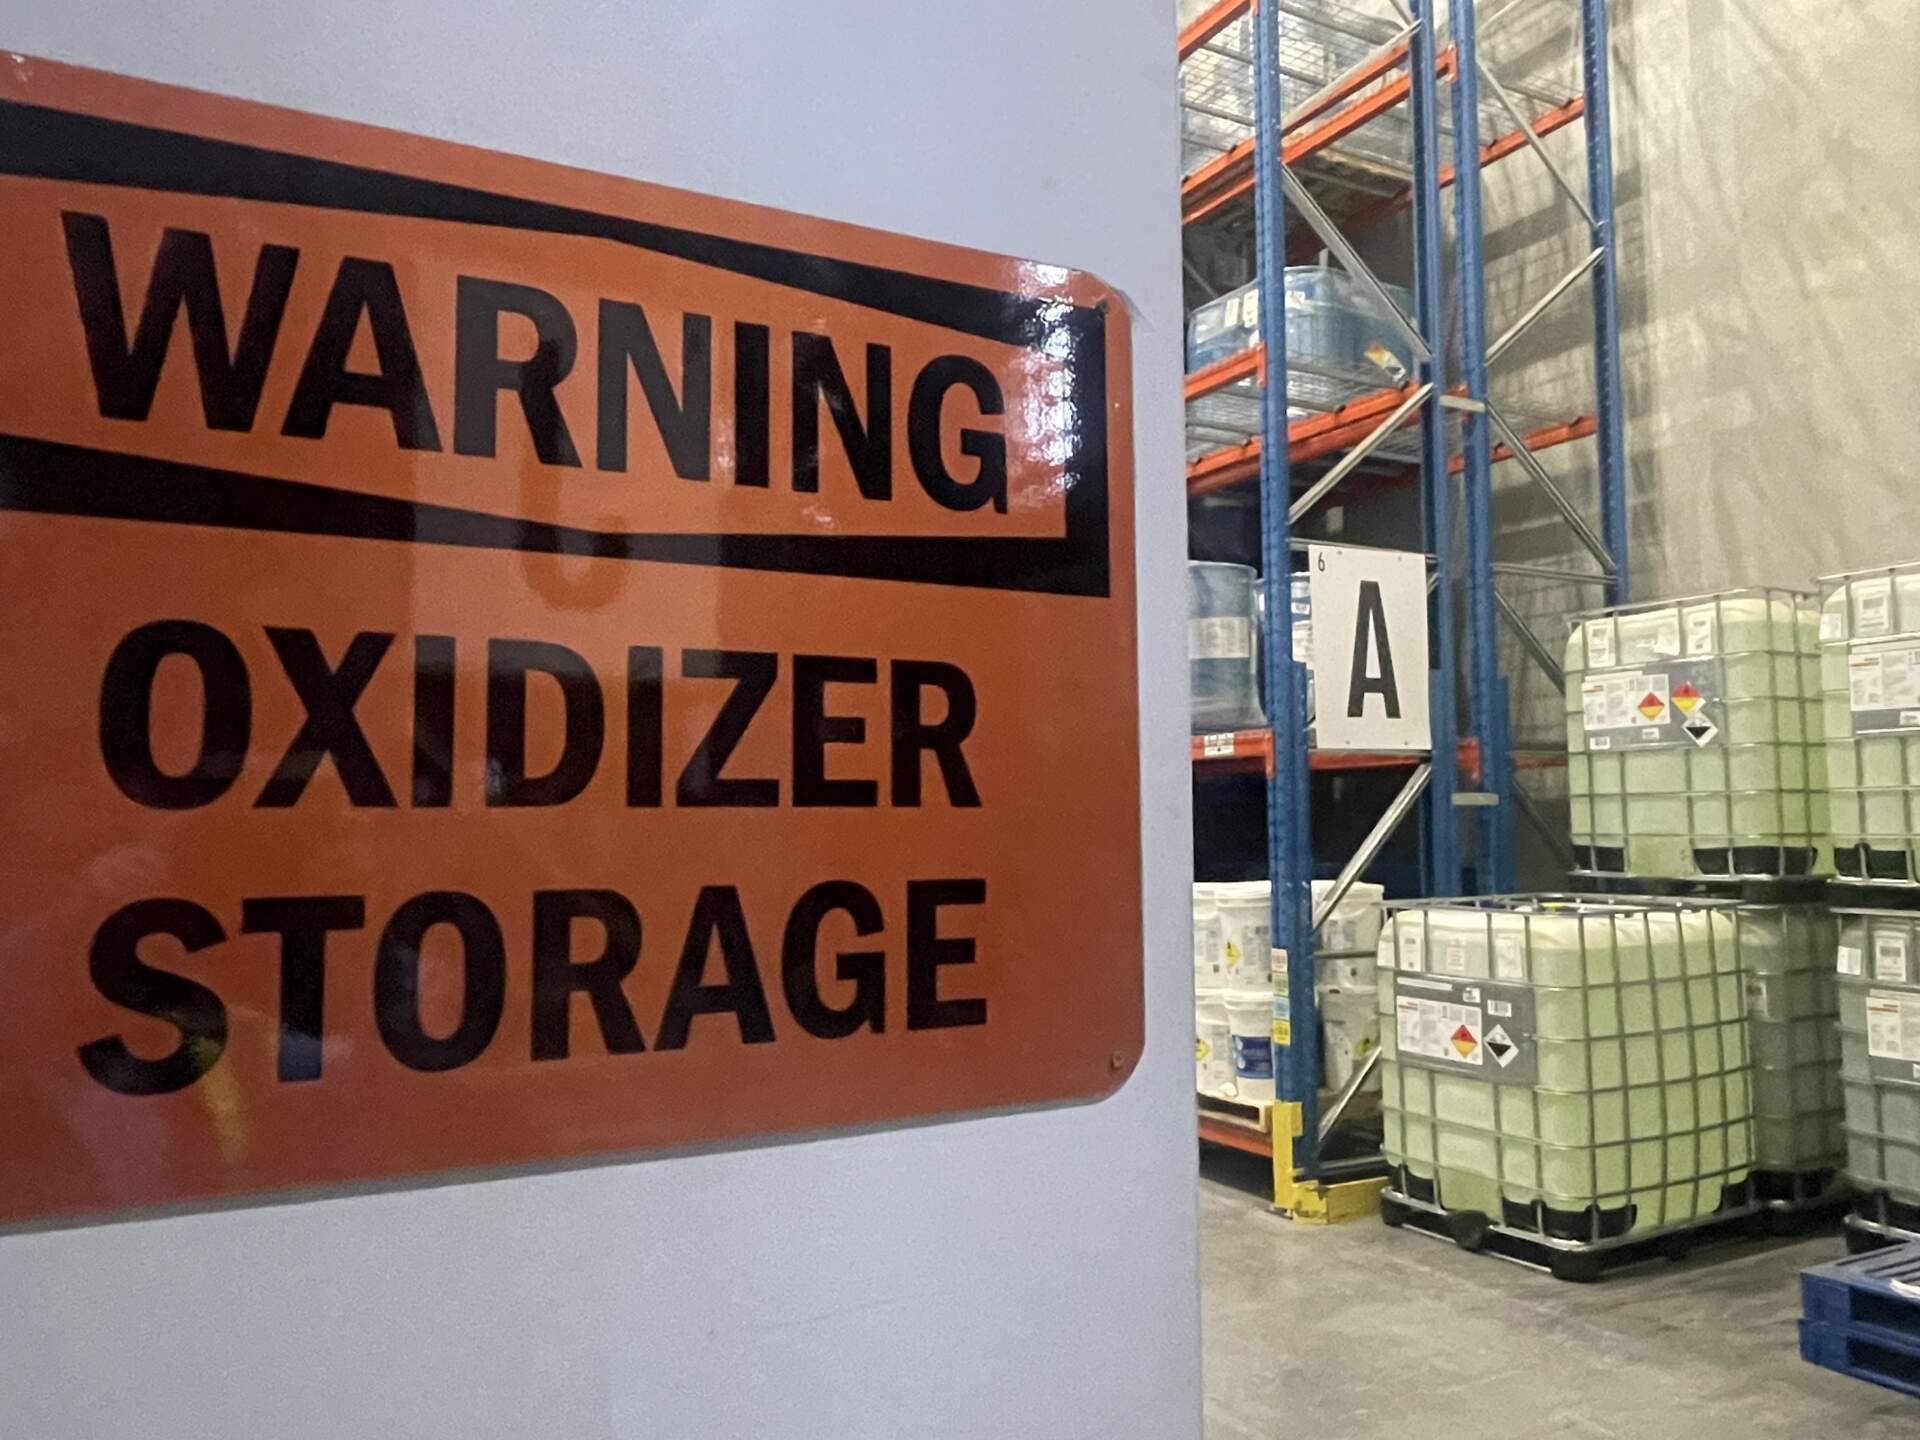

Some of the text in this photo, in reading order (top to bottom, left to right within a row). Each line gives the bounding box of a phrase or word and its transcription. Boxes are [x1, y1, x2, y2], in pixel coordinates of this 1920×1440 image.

[61, 210, 1008, 515] WARNING
[1317, 552, 1326, 572] 6
[1347, 580, 1401, 719] A
[99, 619, 982, 810] OXIDIZER
[76, 878, 987, 1096] STORAGE
